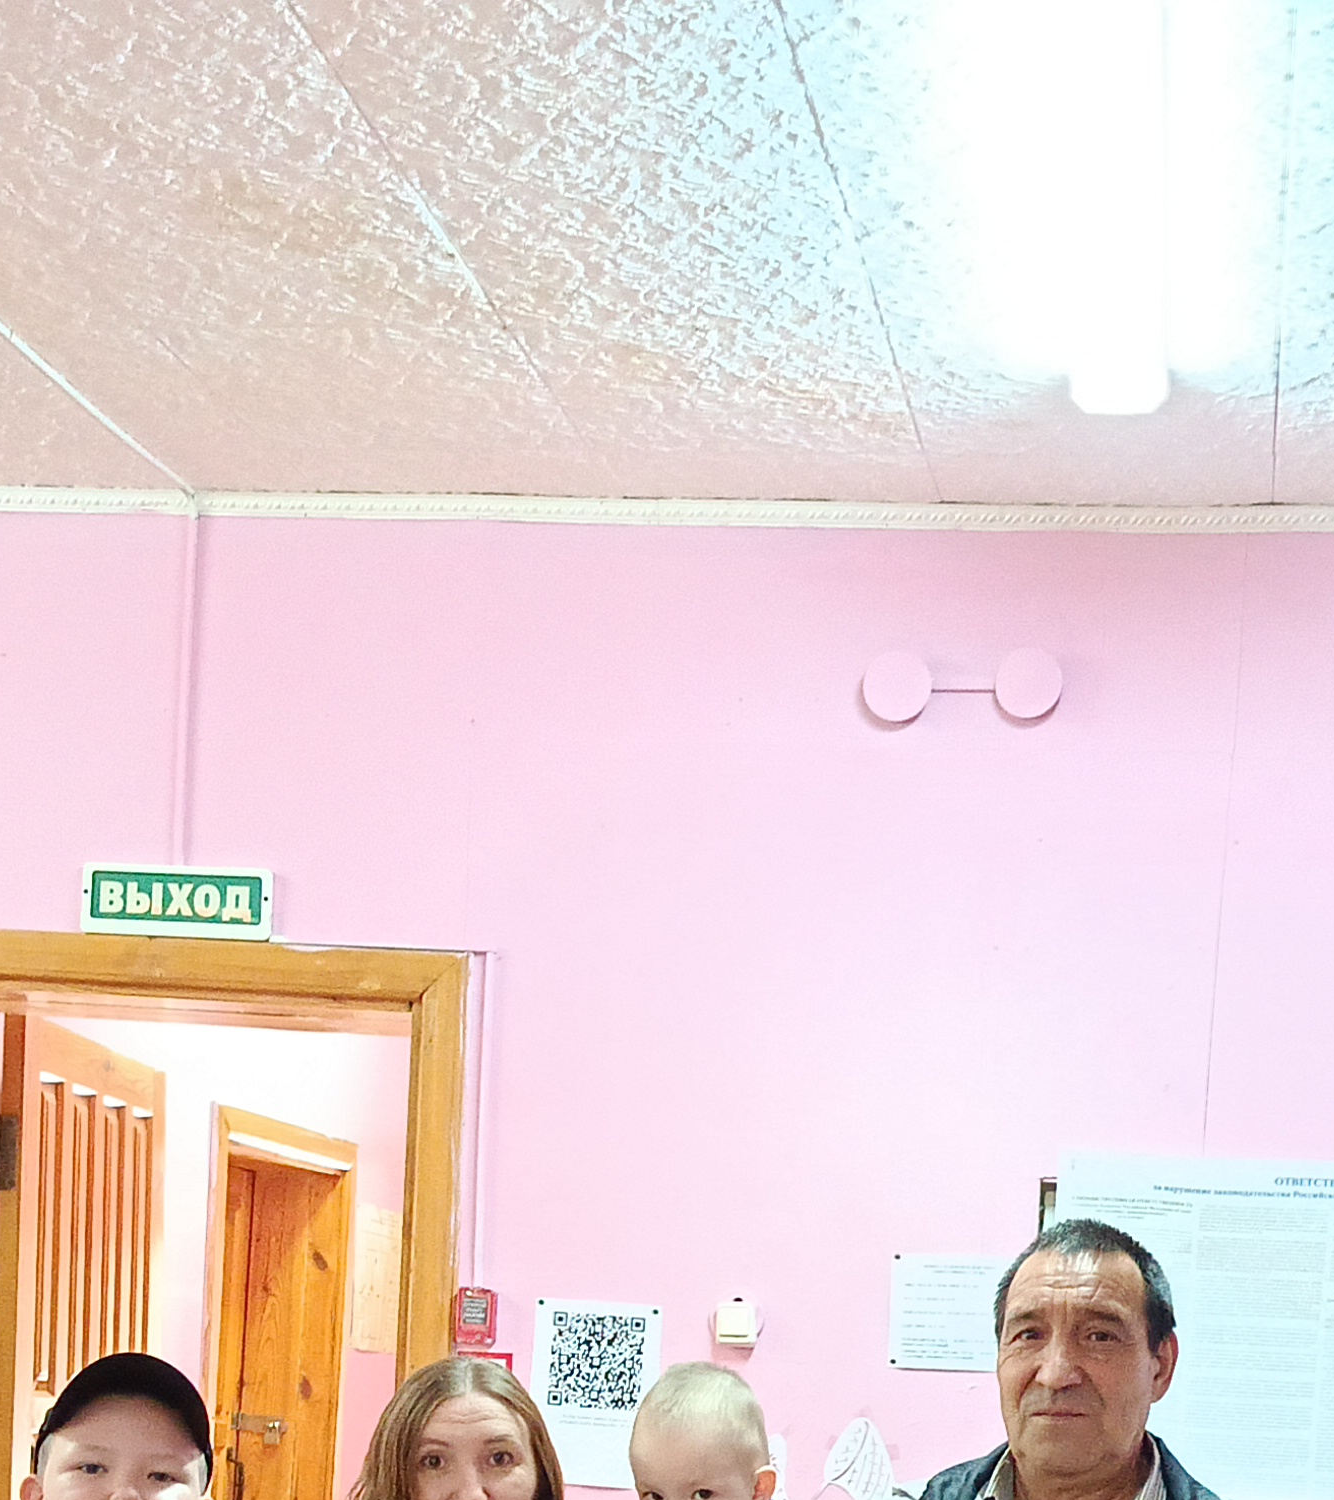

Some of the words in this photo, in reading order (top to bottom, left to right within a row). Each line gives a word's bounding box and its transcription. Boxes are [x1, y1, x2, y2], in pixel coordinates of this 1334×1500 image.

[98, 879, 252, 923] ВЫХОД
[1164, 1185, 1211, 1195] нарушение
[1213, 1188, 1290, 1198] законодательства
